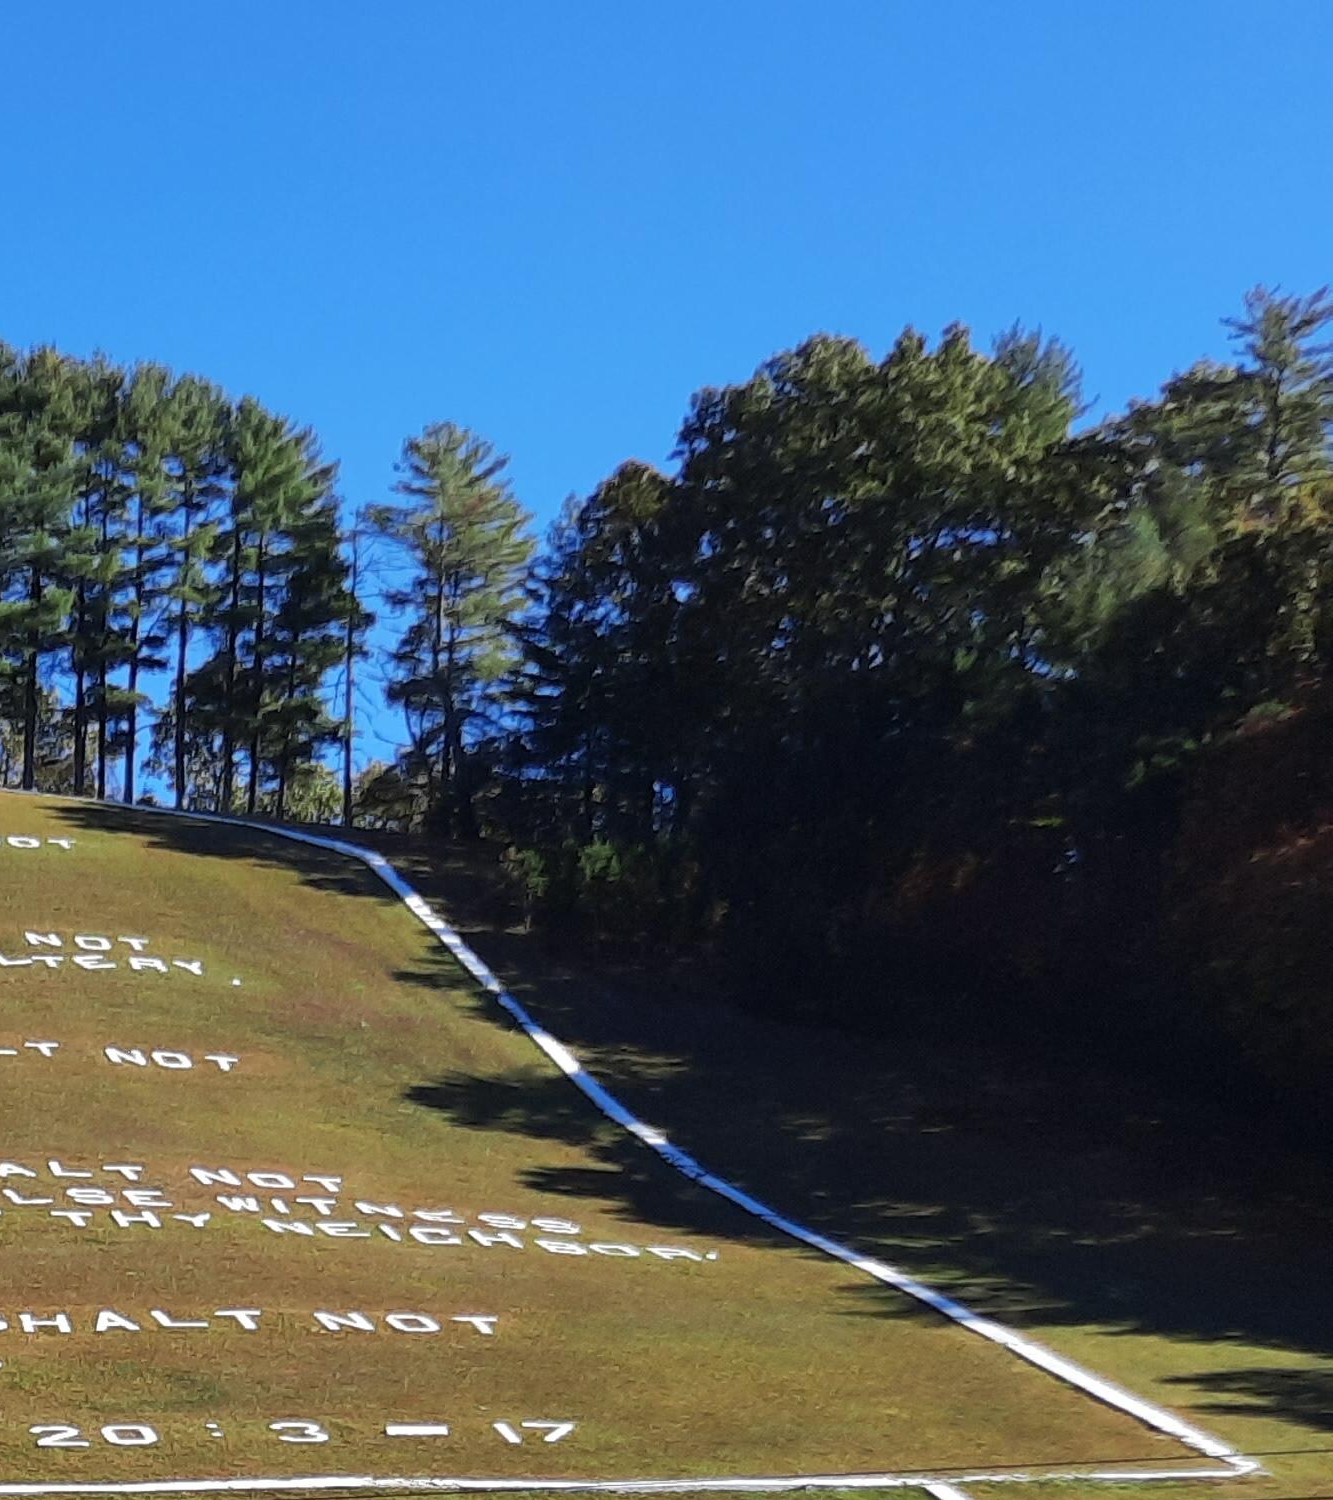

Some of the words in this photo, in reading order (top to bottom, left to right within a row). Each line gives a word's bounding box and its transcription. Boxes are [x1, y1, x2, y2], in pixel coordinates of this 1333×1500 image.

[24, 931, 149, 951] NOT
[105, 1047, 239, 1072] NOT
[190, 1168, 342, 1193] NOT
[50, 1210, 211, 1228] THY
[216, 1196, 582, 1235] WITNESS
[313, 1311, 498, 1334] NOT
[29, 1424, 158, 1447] 20
[269, 1421, 329, 1443] 3
[493, 1421, 574, 1444] 17
